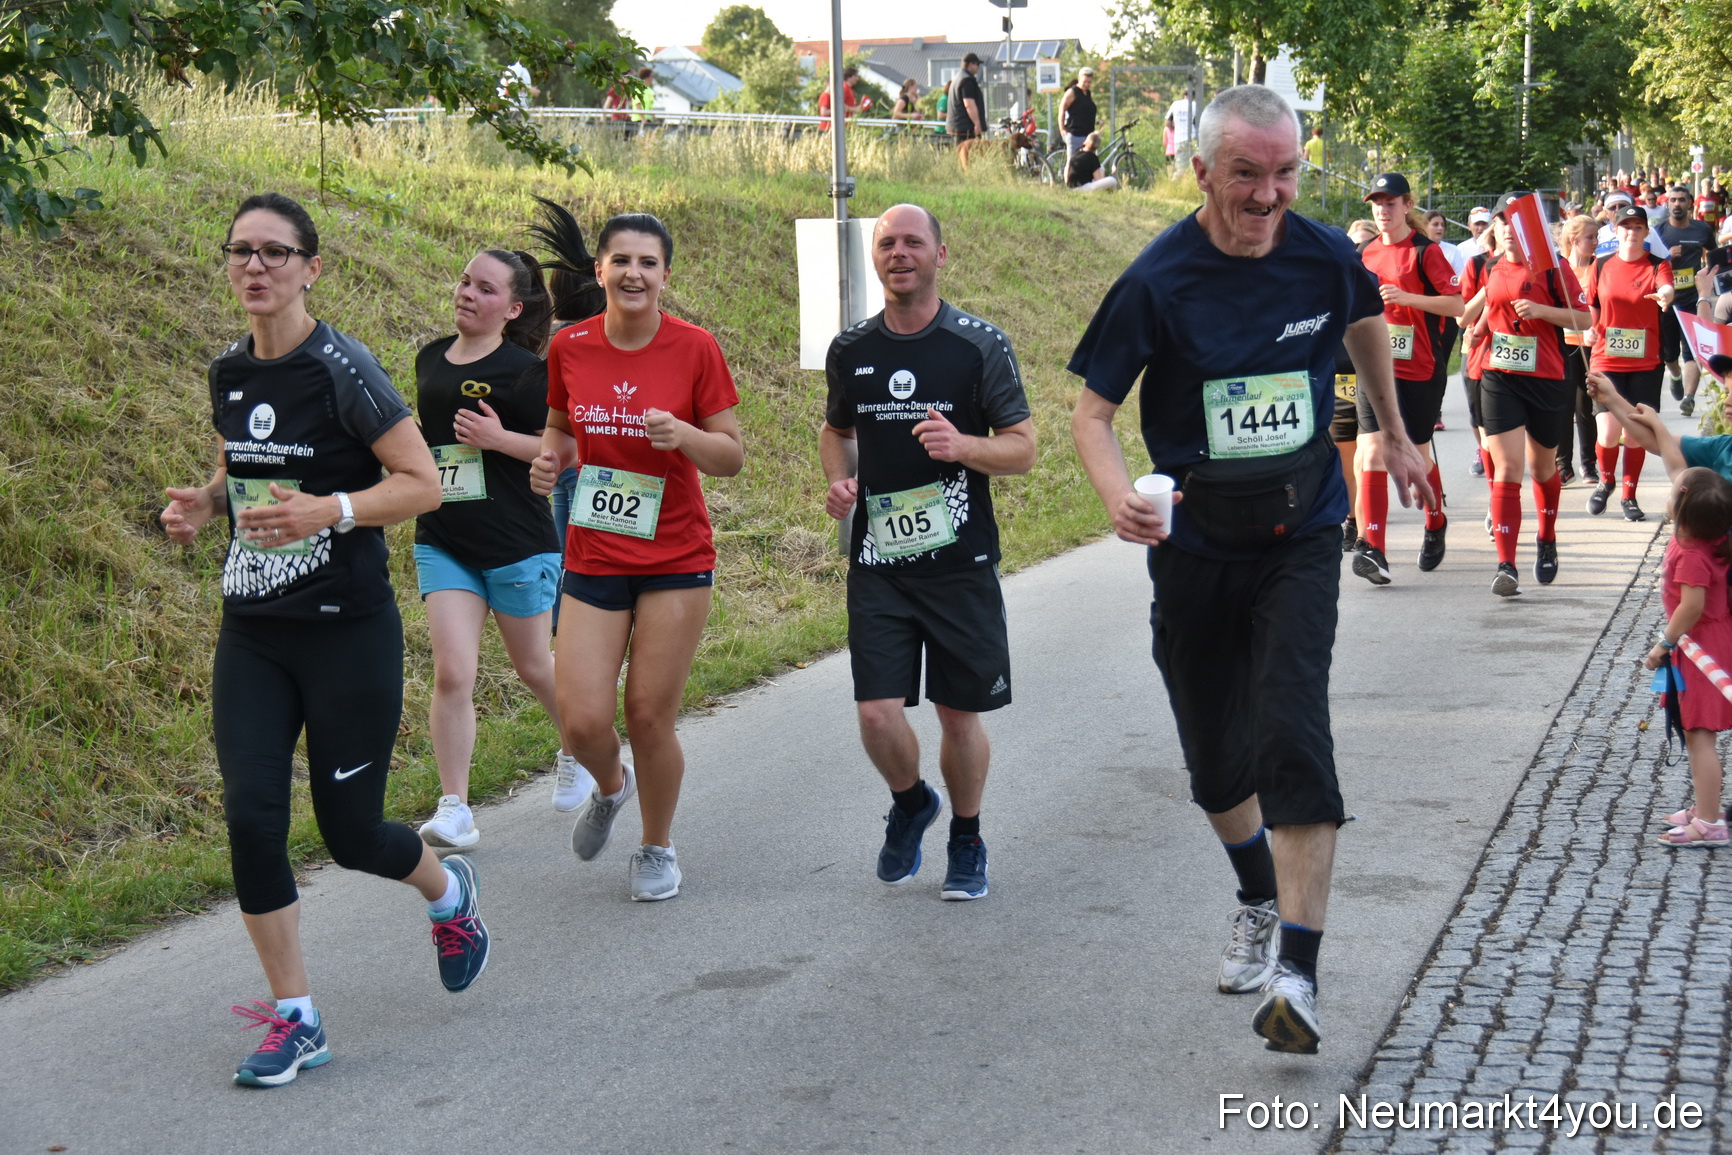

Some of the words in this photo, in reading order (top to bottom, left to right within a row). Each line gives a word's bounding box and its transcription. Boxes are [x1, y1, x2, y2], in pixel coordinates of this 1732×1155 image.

[1391, 336, 1406, 349] 38
[1609, 337, 1640, 350] 2330
[1495, 345, 1529, 361] 2356
[855, 366, 874, 376] JAKO
[1286, 393, 1305, 401] 2019
[574, 405, 610, 423] Echtes
[612, 407, 647, 426] Hand
[876, 412, 929, 421] SCHOTTERWERKE
[1220, 401, 1300, 436] 1444
[585, 425, 618, 436] IMMER
[1237, 436, 1263, 445] Schöll
[1265, 433, 1287, 442] Josef
[231, 453, 286, 465] SCHOTTERWERKE
[640, 491, 657, 499] 2019
[592, 489, 641, 519] 602
[590, 511, 609, 520] Meier
[610, 514, 637, 526] Ramona
[885, 510, 931, 539] 105
[918, 531, 940, 541] Rainer
